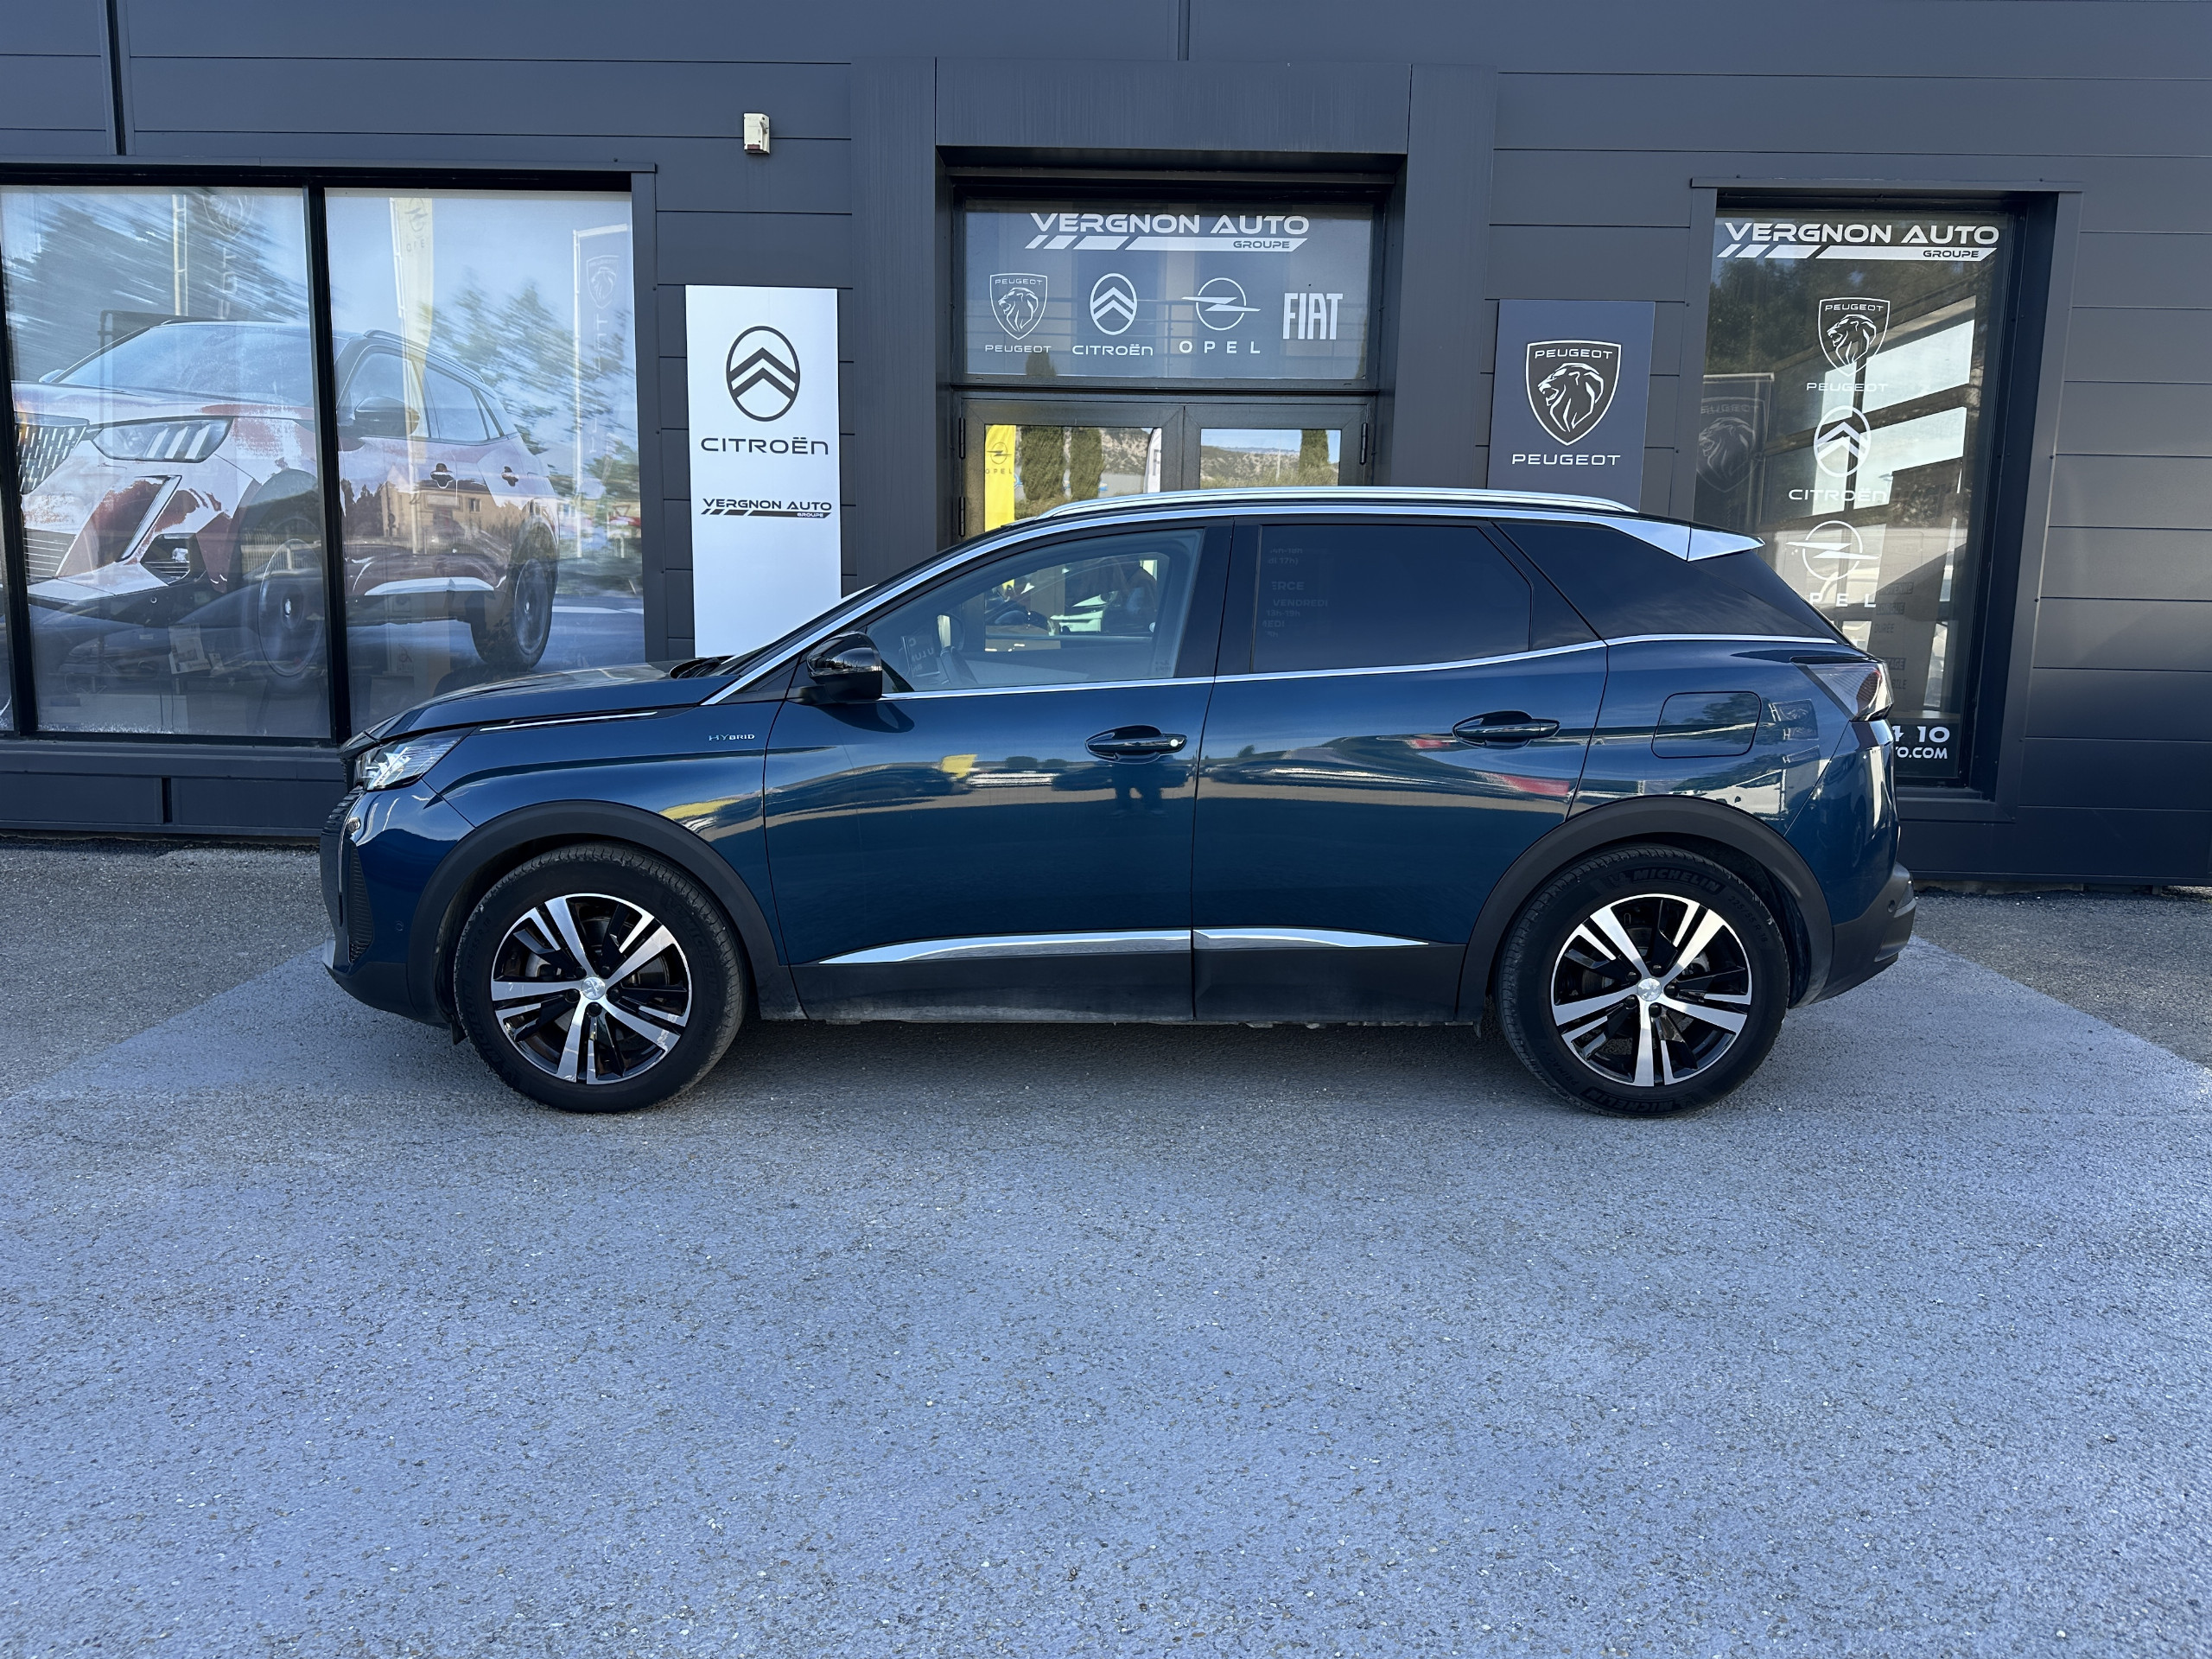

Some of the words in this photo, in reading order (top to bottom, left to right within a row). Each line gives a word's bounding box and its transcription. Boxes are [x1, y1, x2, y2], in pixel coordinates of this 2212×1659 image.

[1030, 212, 1200, 233] VERGNON
[1210, 214, 1310, 235] AUTO
[1724, 222, 1892, 243] VERGNON
[1900, 224, 1999, 245] AUTO
[1233, 240, 1290, 249] GROUPE
[1923, 250, 1980, 258] GROUPE
[995, 277, 1043, 286] PEUGEOT
[1824, 303, 1885, 312] PEUGEOT
[1282, 292, 1344, 340] FIAT
[985, 345, 1052, 353] PEUGEOT
[1179, 340, 1261, 355] OPEL
[1534, 348, 1613, 359] PEUGEOT
[1806, 382, 1890, 392] PEUGEOT
[1511, 454, 1621, 466] PEUGEOT
[702, 498, 782, 510] VERGNON
[786, 501, 832, 511] AUTO
[1273, 599, 1328, 607] VENDREDI
[1809, 593, 1877, 608] PEL
[708, 734, 756, 742] HYBRID
[1916, 726, 1950, 743] 10
[1895, 747, 1948, 760] O.COM
[1632, 868, 1721, 893] MICHELIN
[1586, 1090, 1674, 1113] MICHELIN
